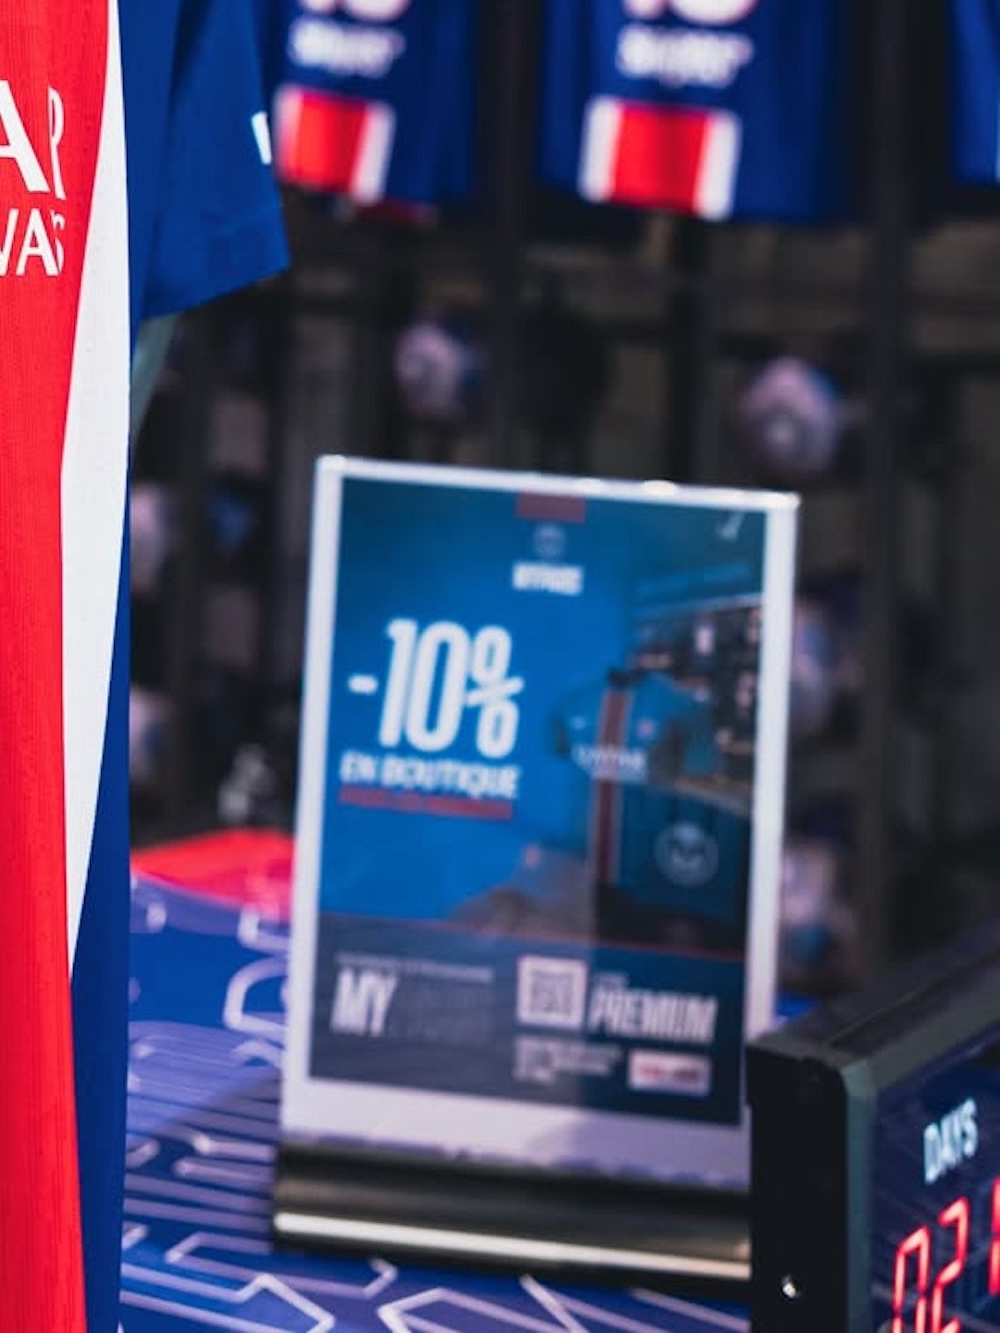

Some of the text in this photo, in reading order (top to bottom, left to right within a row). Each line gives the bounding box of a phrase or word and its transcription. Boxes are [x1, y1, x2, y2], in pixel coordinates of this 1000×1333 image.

[348, 618, 525, 760] -10%
[340, 748, 377, 785] EN
[380, 752, 522, 801] BOUTIQUE
[329, 966, 398, 1040] MY
[587, 984, 718, 1046] PREMIUM
[922, 1096, 979, 1184] DAYS
